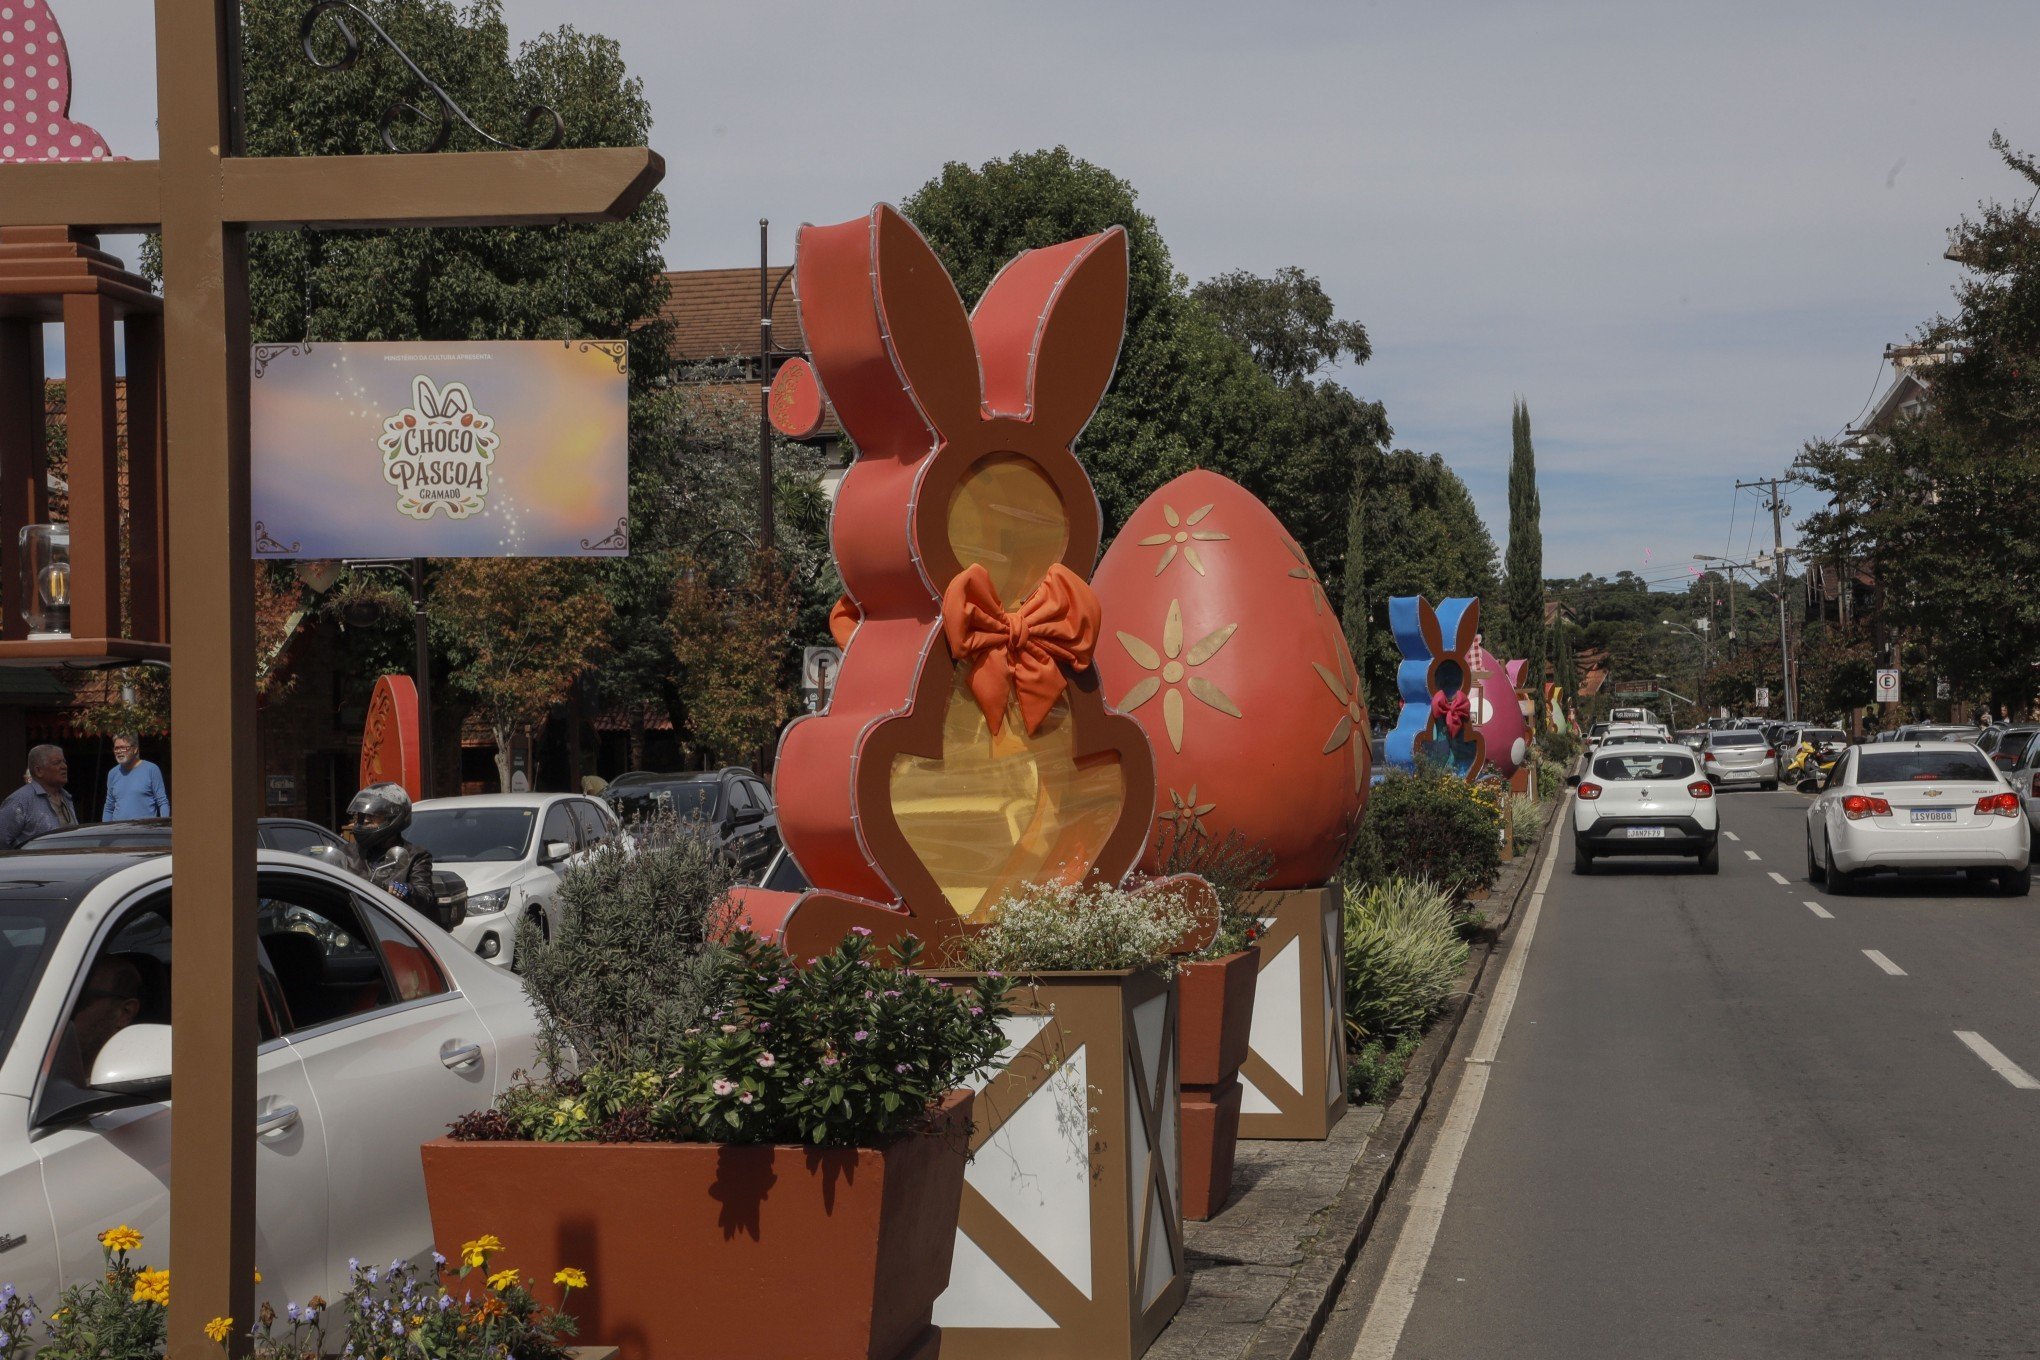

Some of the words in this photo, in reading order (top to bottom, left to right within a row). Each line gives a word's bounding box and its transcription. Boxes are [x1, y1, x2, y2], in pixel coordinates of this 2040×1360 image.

[404, 428, 473, 456] CHOCO
[389, 455, 483, 490] PÁSCOA
[419, 488, 461, 500] GRAMADO
[1884, 677, 1891, 687] E
